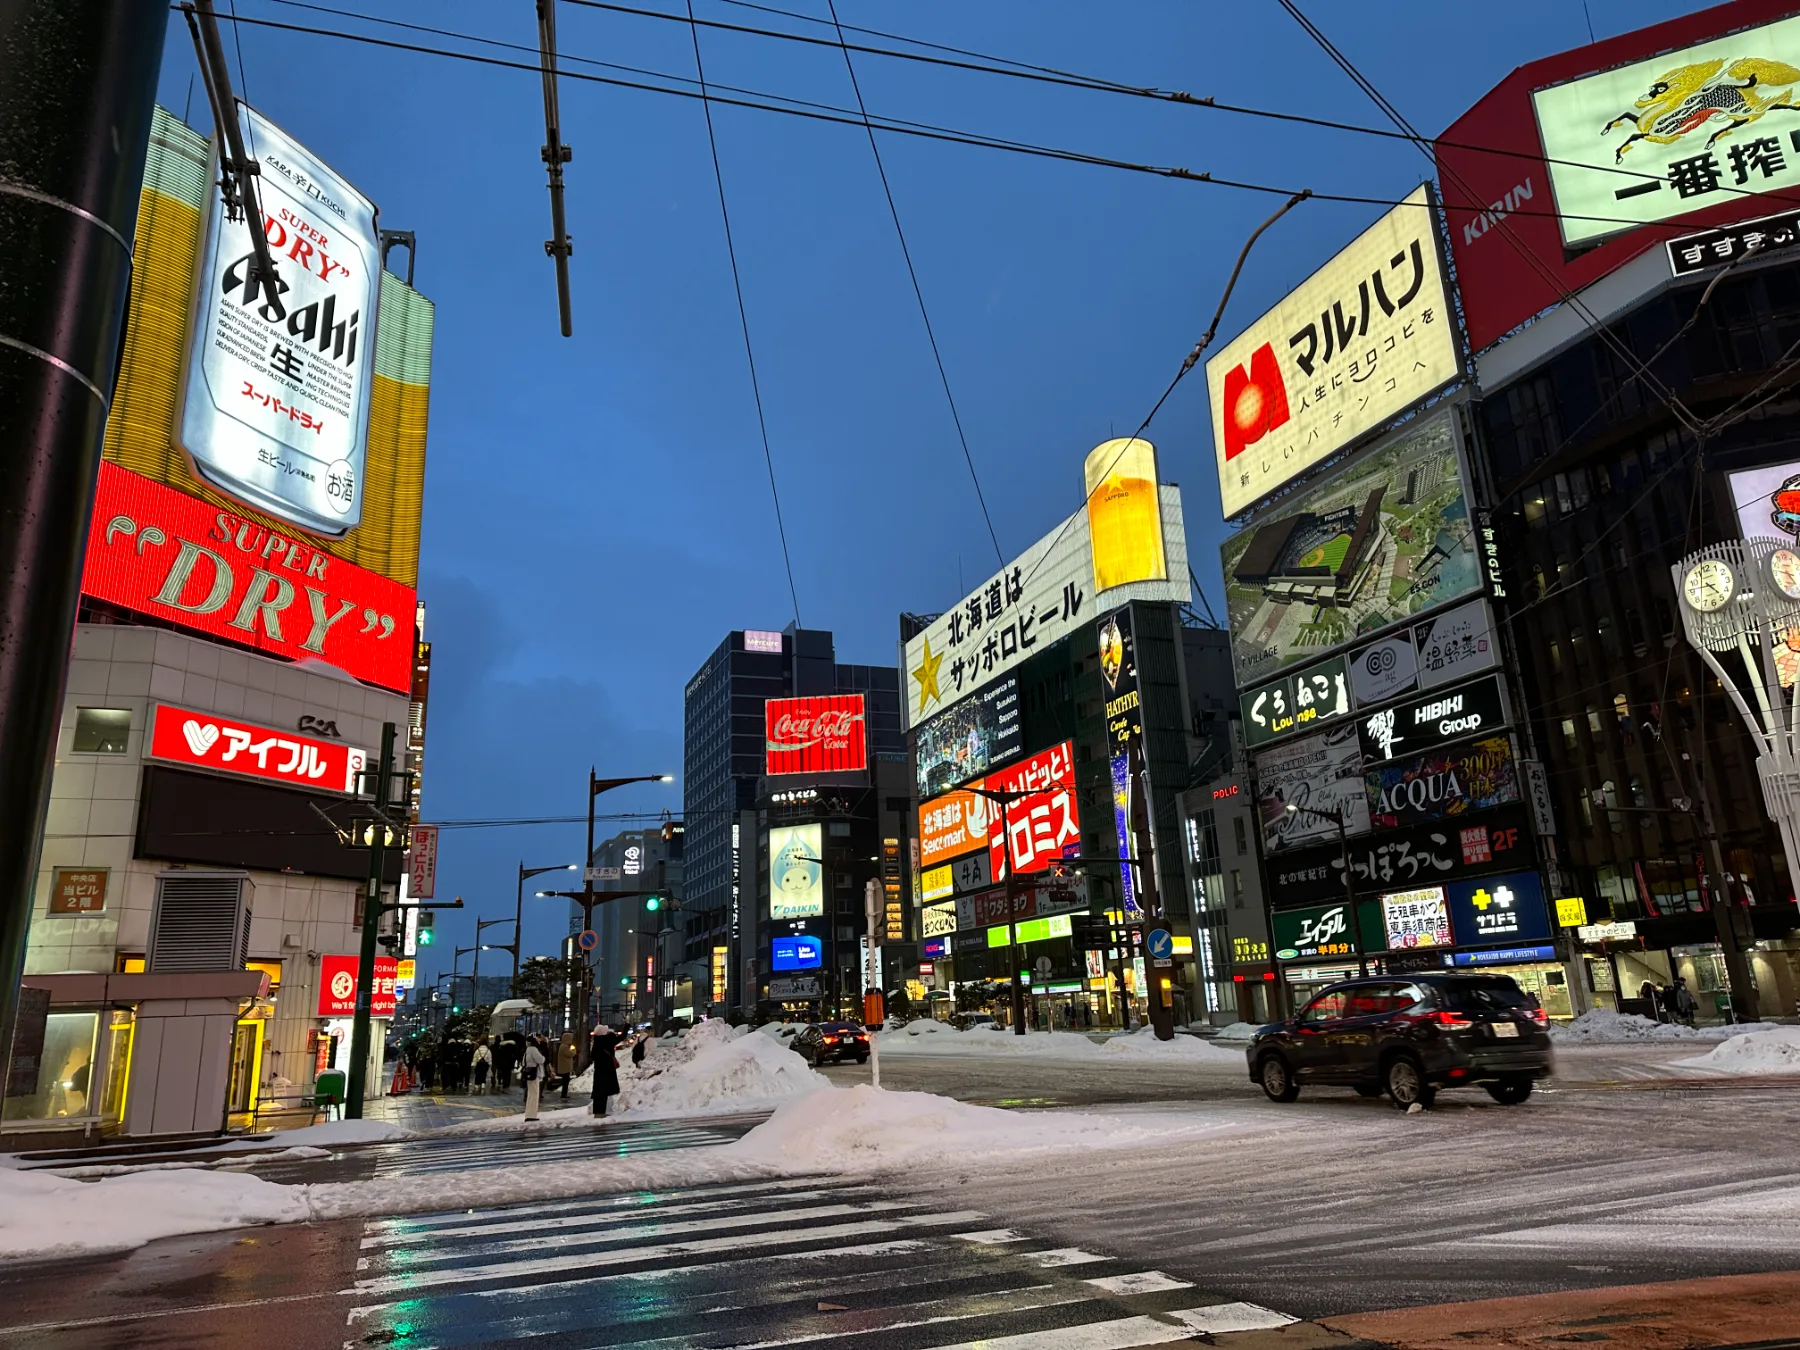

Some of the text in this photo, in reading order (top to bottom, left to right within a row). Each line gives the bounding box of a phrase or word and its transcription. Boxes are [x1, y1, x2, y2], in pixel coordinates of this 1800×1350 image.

[1614, 129, 1800, 201] 一番搾
[265, 155, 347, 219] KARA 辛口 KUCHI
[278, 207, 329, 249] SUPER
[1462, 177, 1534, 246] KIRIN
[258, 208, 350, 283] DRY”
[1288, 238, 1425, 378] マルハン
[269, 342, 304, 384] 生
[1300, 307, 1434, 413] 人生にヨロコビを
[241, 381, 323, 435] スーパードライ
[1240, 361, 1427, 488] 新しいパチンコへ
[257, 448, 295, 475] 生ビール
[327, 473, 354, 502] お酒
[210, 513, 330, 582] SUPER
[947, 566, 1023, 648] 北海道は
[950, 581, 1083, 692] サッポロビール
[1248, 645, 1278, 666] VILLAGE
[998, 708, 1018, 724] Sapporo
[1251, 674, 1329, 728] くろねこ
[1414, 695, 1463, 725] HIBIKI
[773, 710, 852, 741] Coca-Cola
[1272, 707, 1317, 732] Lounge
[1439, 713, 1482, 736] Group
[221, 726, 328, 779] アイフル
[1376, 769, 1463, 815] ACQUA
[1469, 779, 1496, 799] 日本
[923, 800, 962, 835] 北海道は
[1492, 828, 1518, 851] 2F
[413, 831, 429, 893] ほっとハウス
[961, 857, 982, 885] 牛角
[1279, 865, 1328, 886] 北の味紀行
[1331, 834, 1454, 887] さっぽろっこ
[63, 885, 99, 896] 当ビル
[70, 874, 97, 882] 中央店
[66, 897, 93, 908] 2階
[782, 904, 820, 915] DAIKIN
[1388, 902, 1438, 921] 元祖串かつ
[1294, 907, 1347, 946] エイブル
[1389, 916, 1447, 935] 恵美須商店
[1587, 927, 1628, 937] すすきのビル
[373, 964, 397, 973] FORMA
